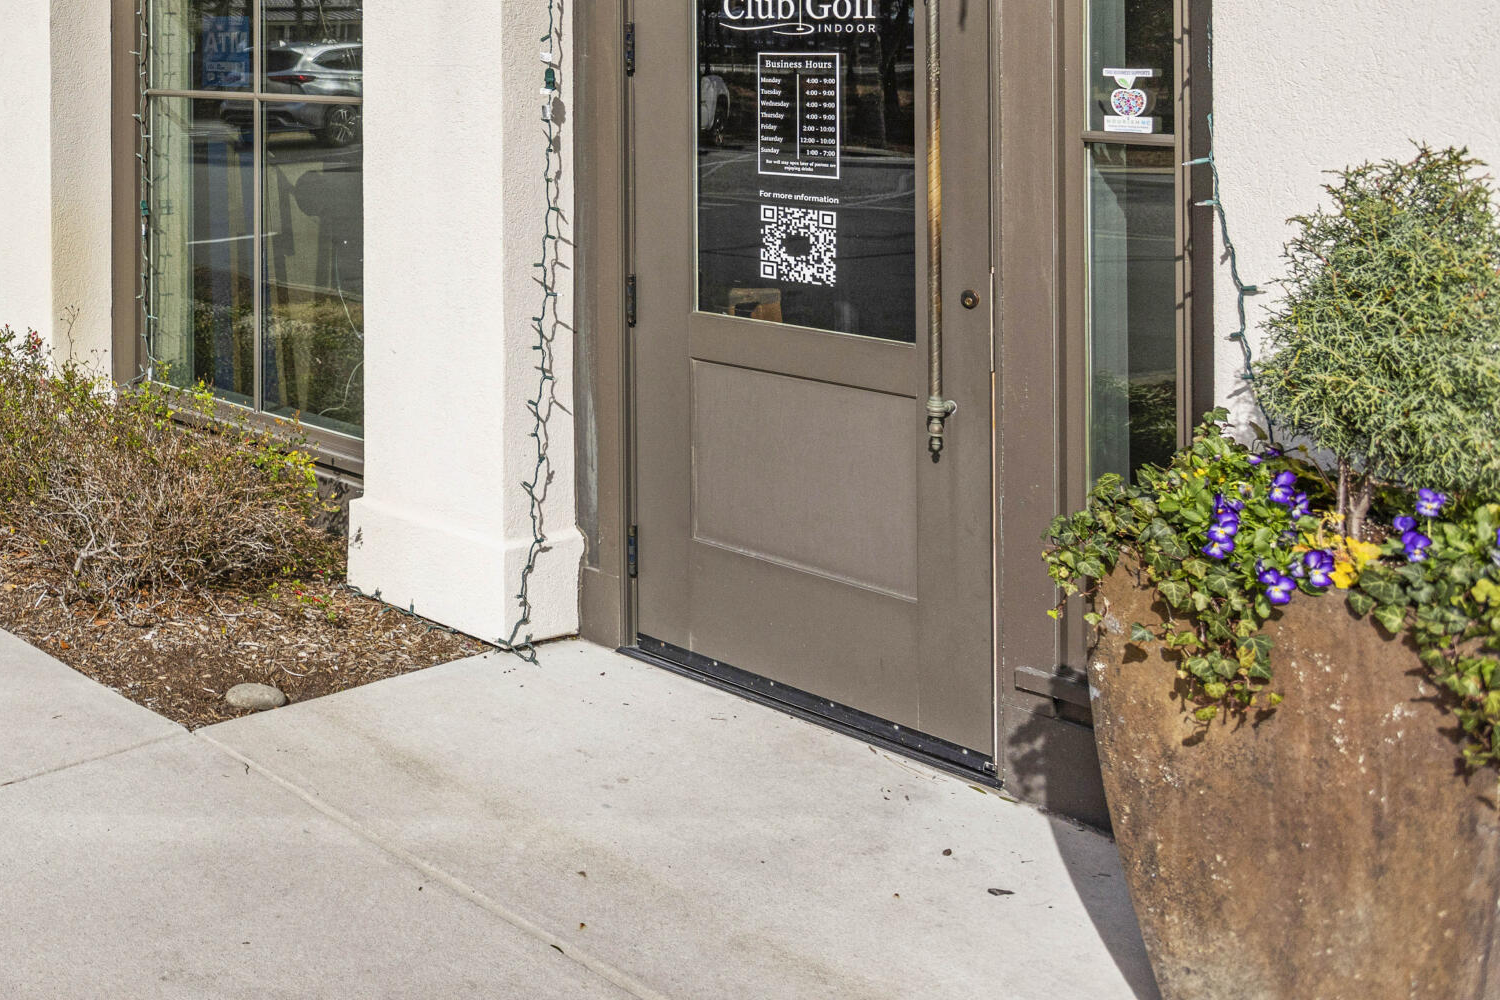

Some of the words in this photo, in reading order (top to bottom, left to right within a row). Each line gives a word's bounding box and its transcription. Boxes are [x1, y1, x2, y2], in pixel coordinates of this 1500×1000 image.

[818, 23, 876, 33] INDOOR
[765, 59, 802, 69] Business
[805, 60, 832, 69] Hours
[760, 100, 790, 108] Wednesday
[761, 112, 784, 120] Thursday
[761, 123, 777, 131] Friday
[761, 135, 783, 143] Saturday
[759, 190, 772, 198] For
[772, 192, 793, 200] more
[794, 193, 840, 204] information
